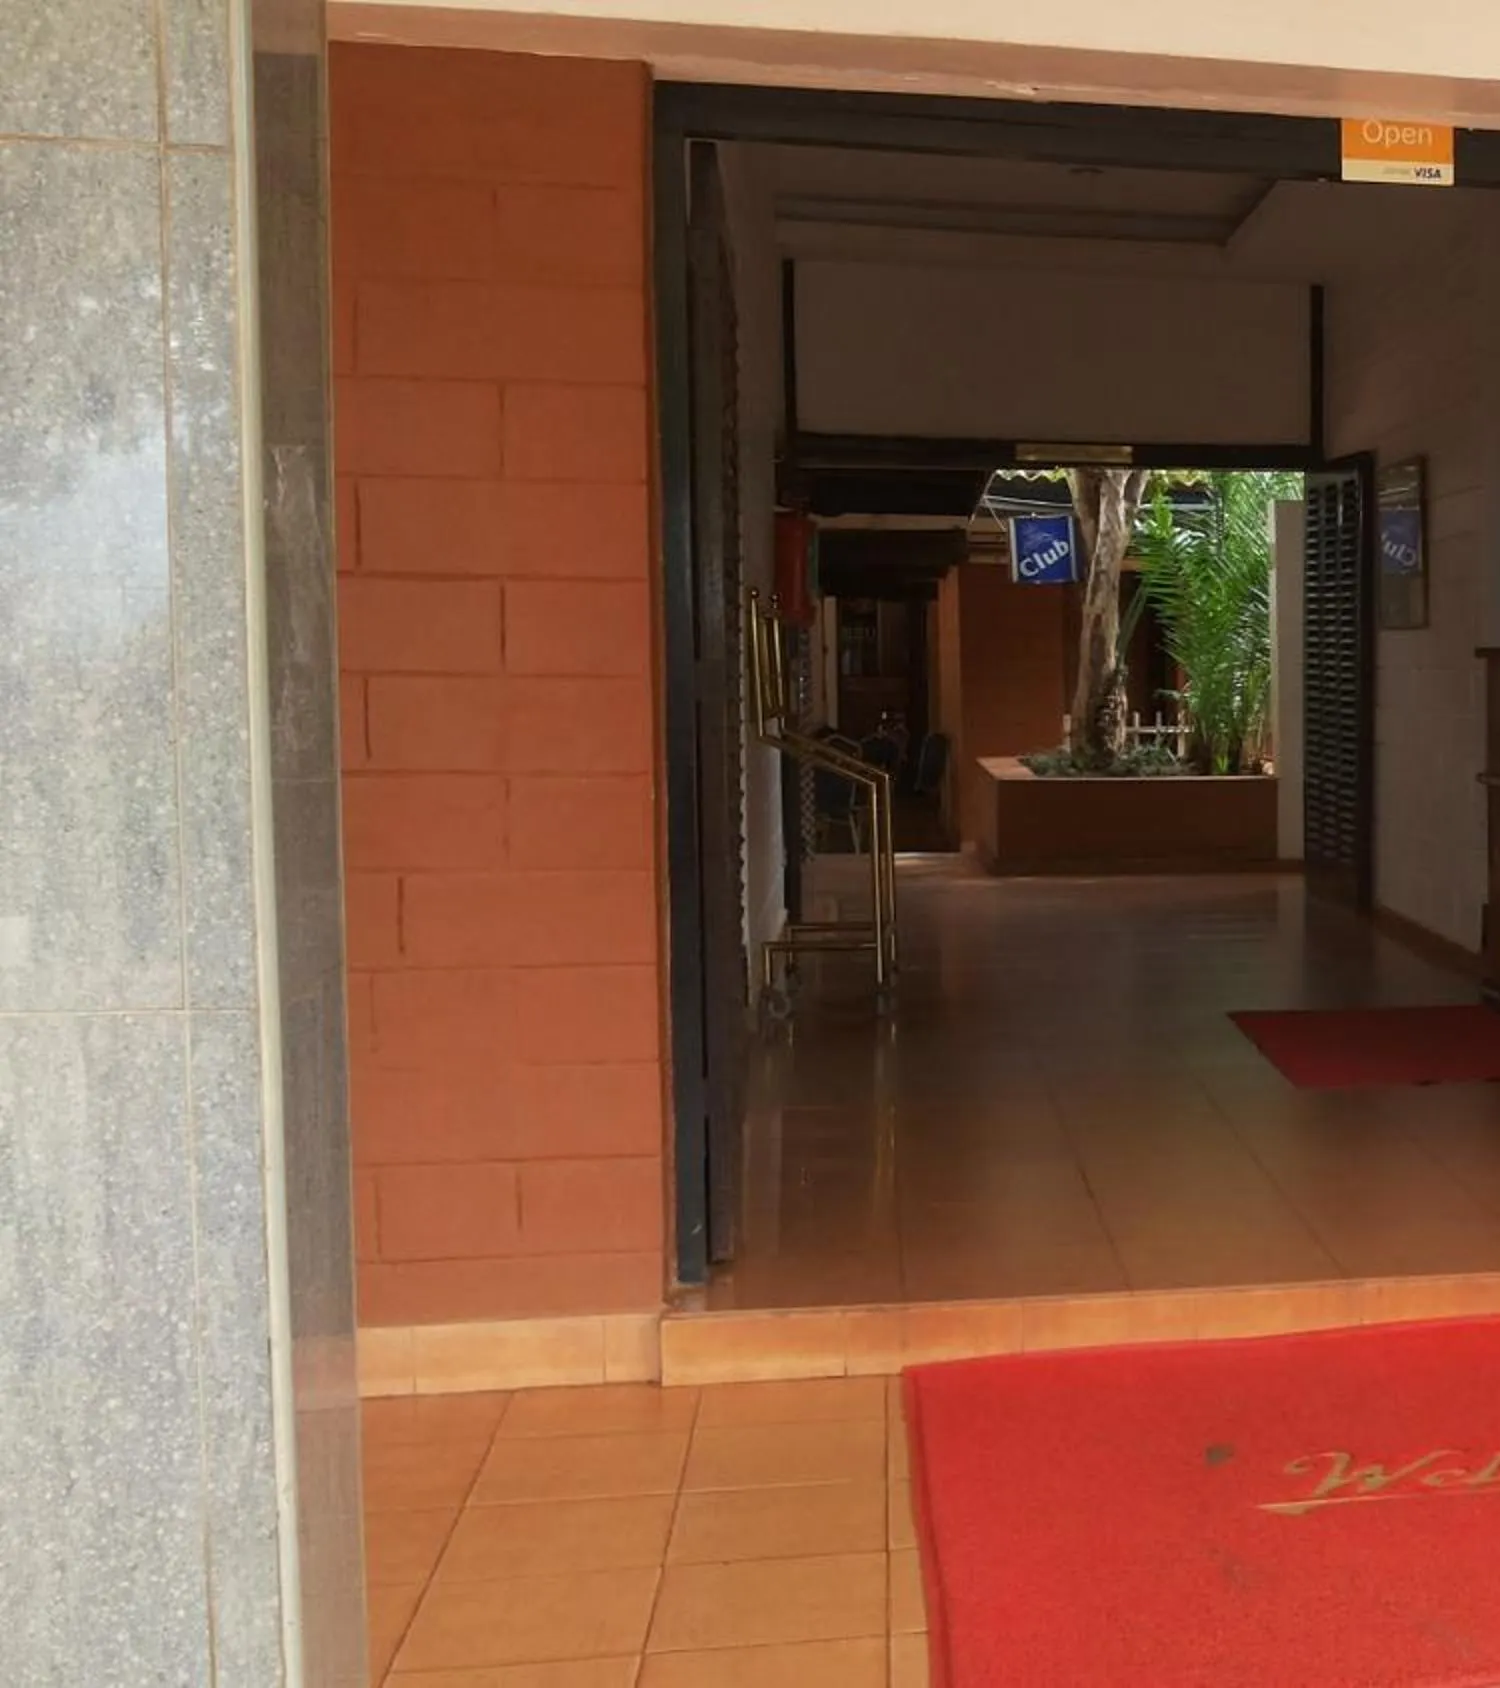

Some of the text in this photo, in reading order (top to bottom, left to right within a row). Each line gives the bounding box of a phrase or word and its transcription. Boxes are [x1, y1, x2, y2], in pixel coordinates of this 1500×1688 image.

[1362, 119, 1433, 148] Open
[1414, 167, 1441, 178] VISA
[1019, 539, 1069, 577] Club
